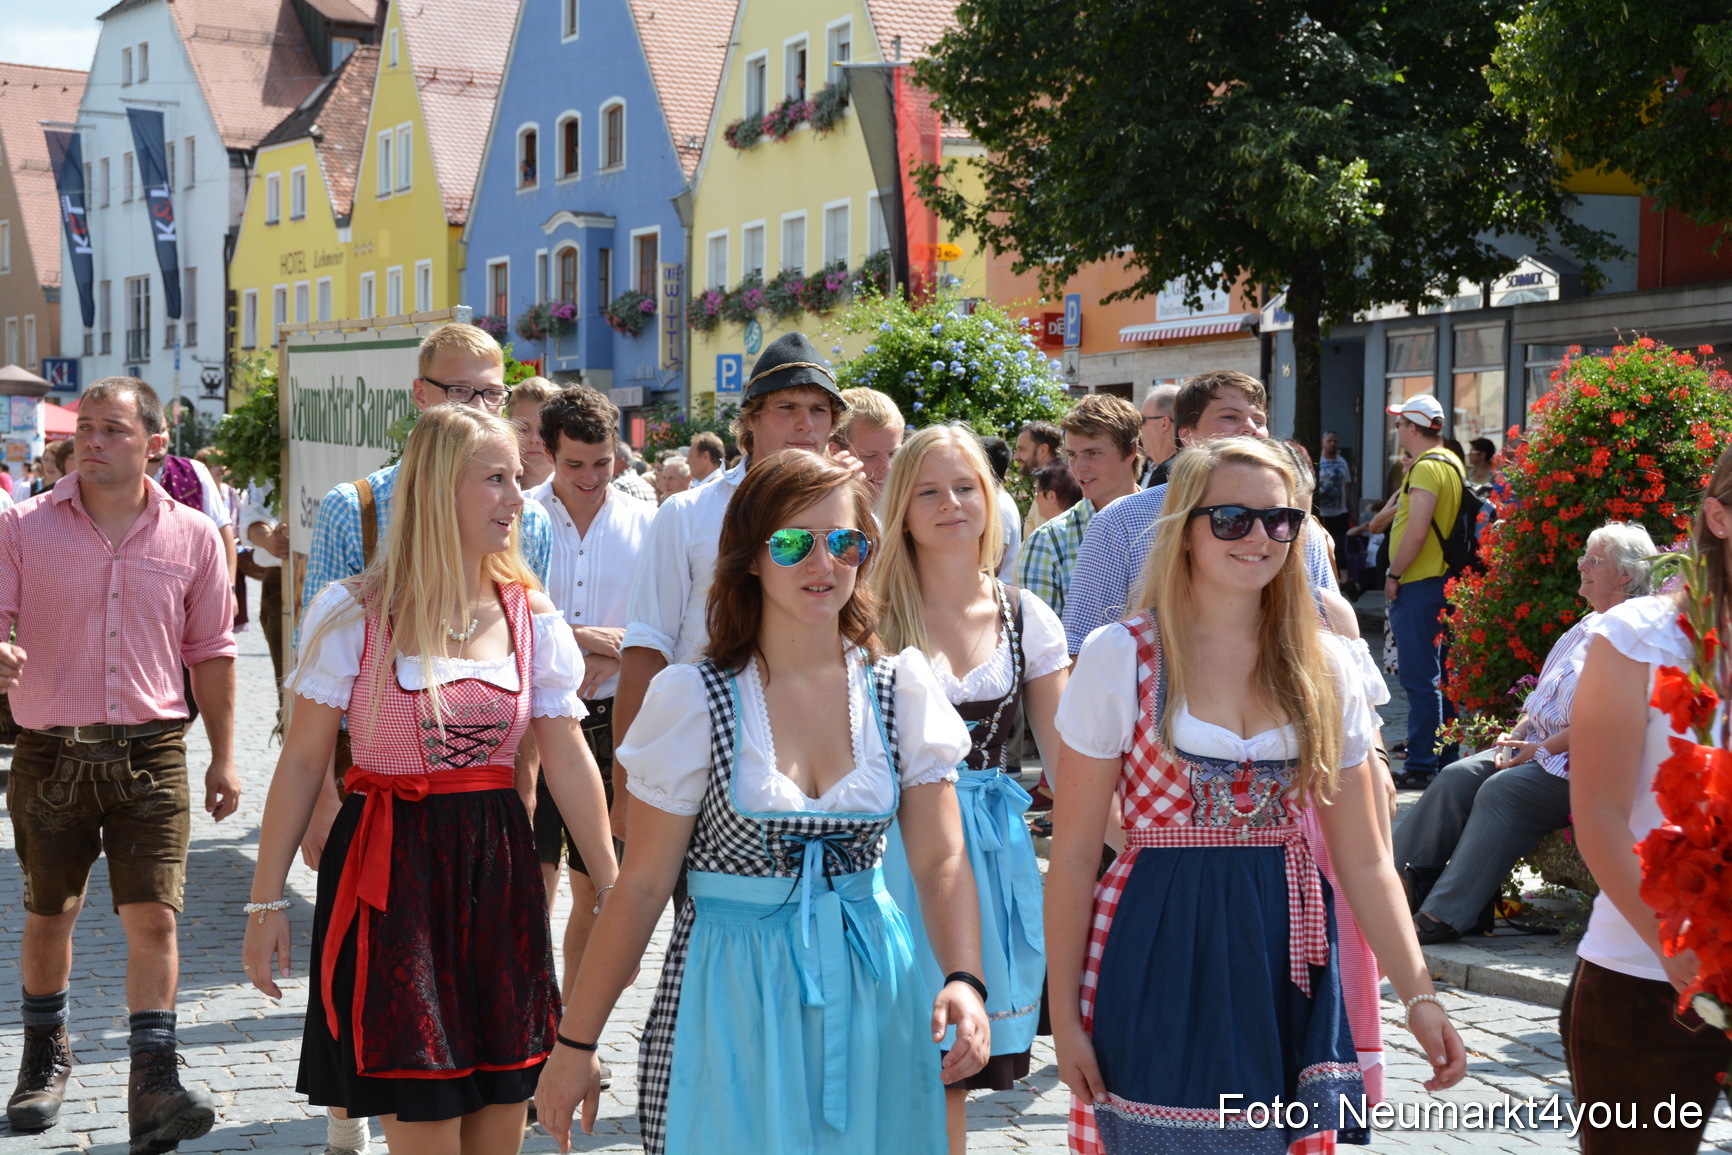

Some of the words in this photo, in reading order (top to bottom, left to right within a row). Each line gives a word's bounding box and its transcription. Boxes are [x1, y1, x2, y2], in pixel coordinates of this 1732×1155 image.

[280, 250, 307, 276] HOTEL
[664, 284, 680, 361] WITTL
[1067, 300, 1078, 339] P
[722, 358, 737, 389] P
[356, 376, 413, 450] Bauern
